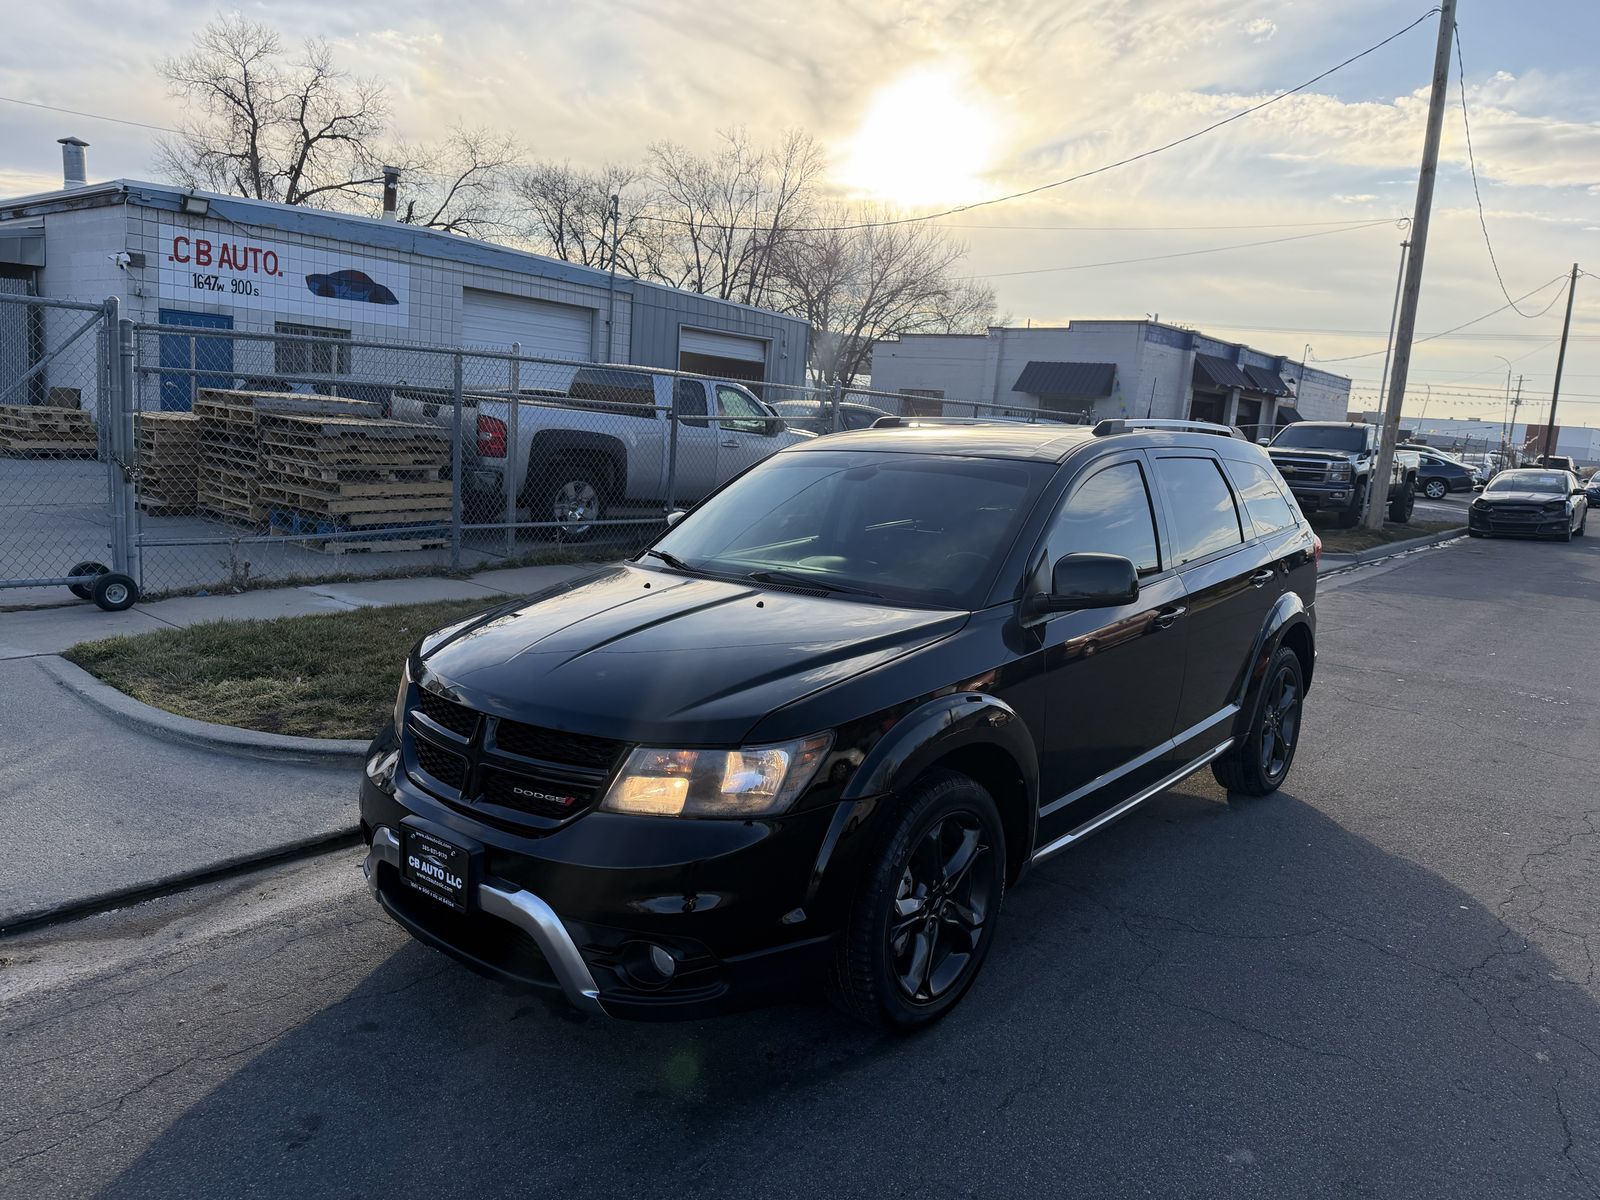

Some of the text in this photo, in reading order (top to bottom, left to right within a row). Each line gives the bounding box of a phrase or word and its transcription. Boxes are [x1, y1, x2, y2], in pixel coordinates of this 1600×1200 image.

[513, 787, 567, 804] DODGE
[408, 855, 463, 889] CB AUTO LLC
